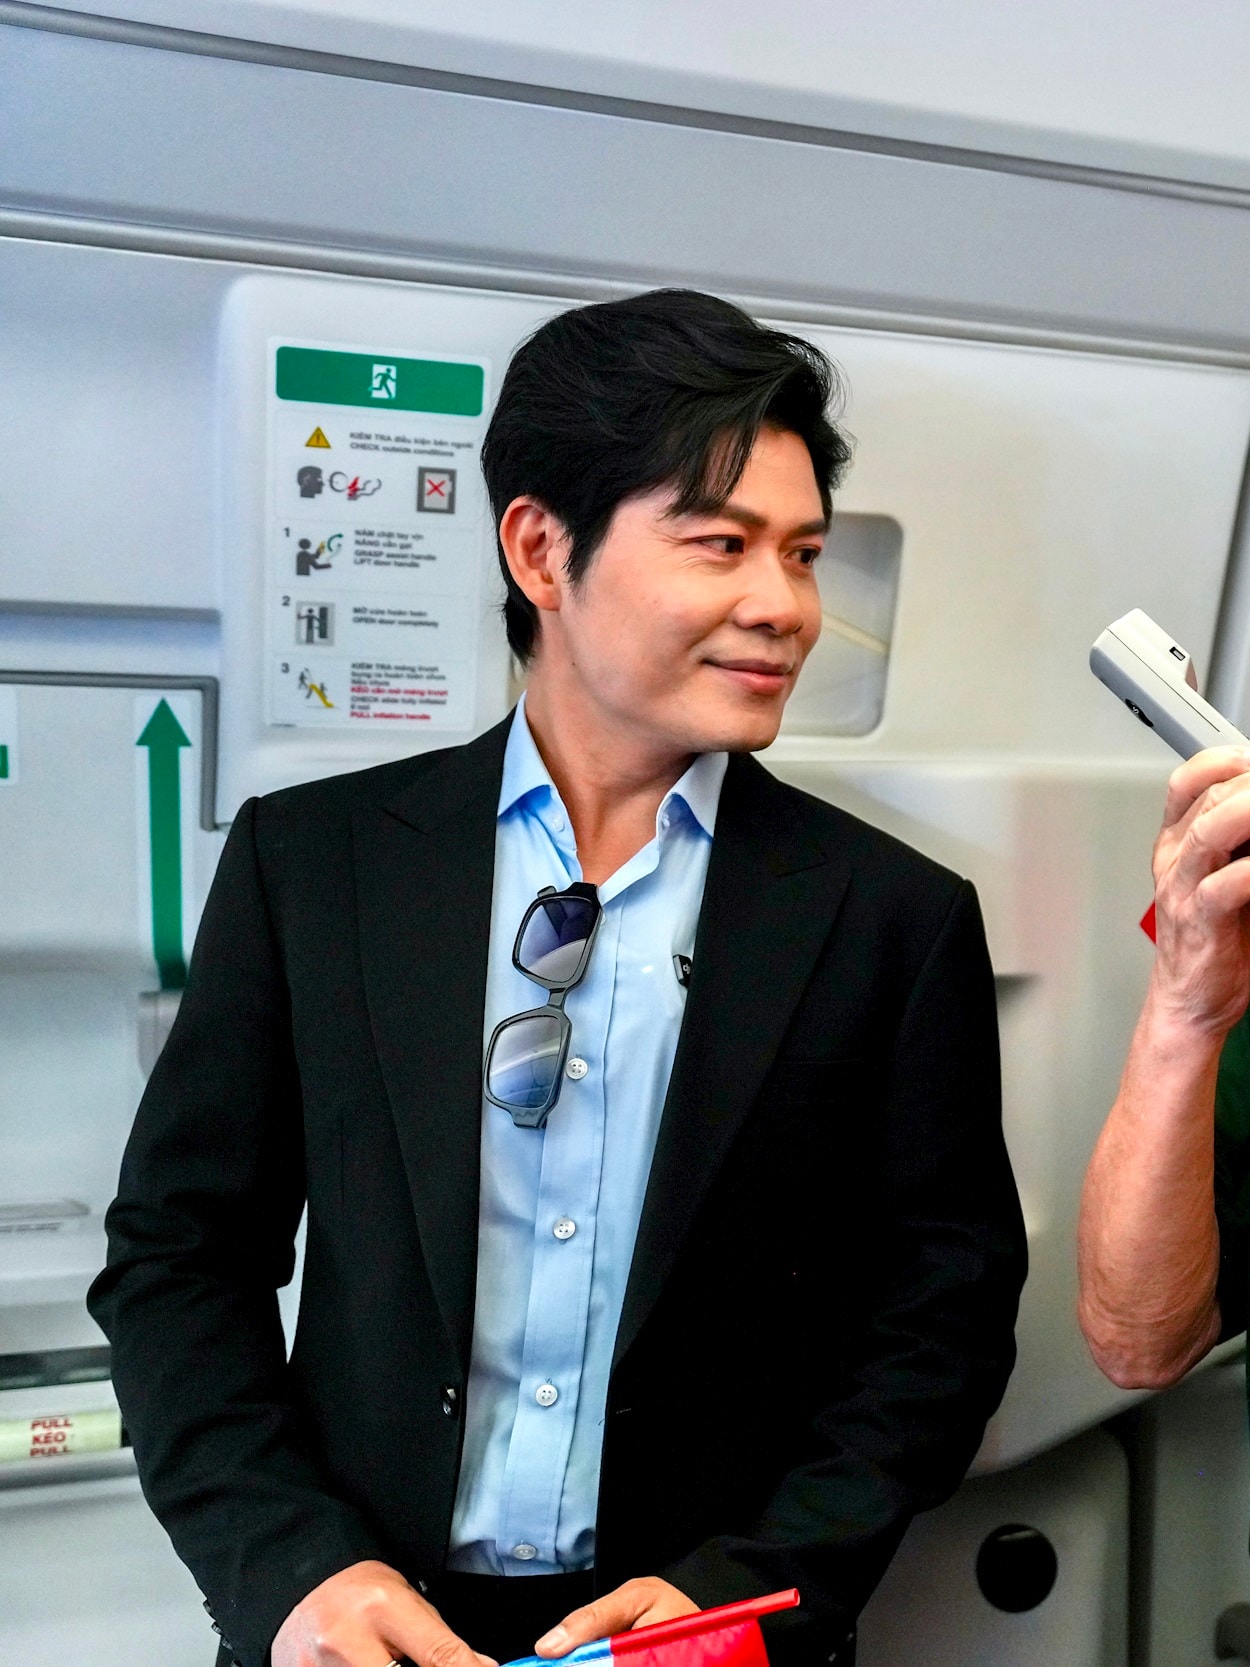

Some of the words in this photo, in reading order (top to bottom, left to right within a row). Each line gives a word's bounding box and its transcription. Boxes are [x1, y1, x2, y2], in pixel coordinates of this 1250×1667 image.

[350, 442, 380, 451] CHECK
[284, 526, 290, 538] 1
[281, 595, 291, 607] 2
[281, 662, 290, 674] 3
[31, 1418, 72, 1430] PULL
